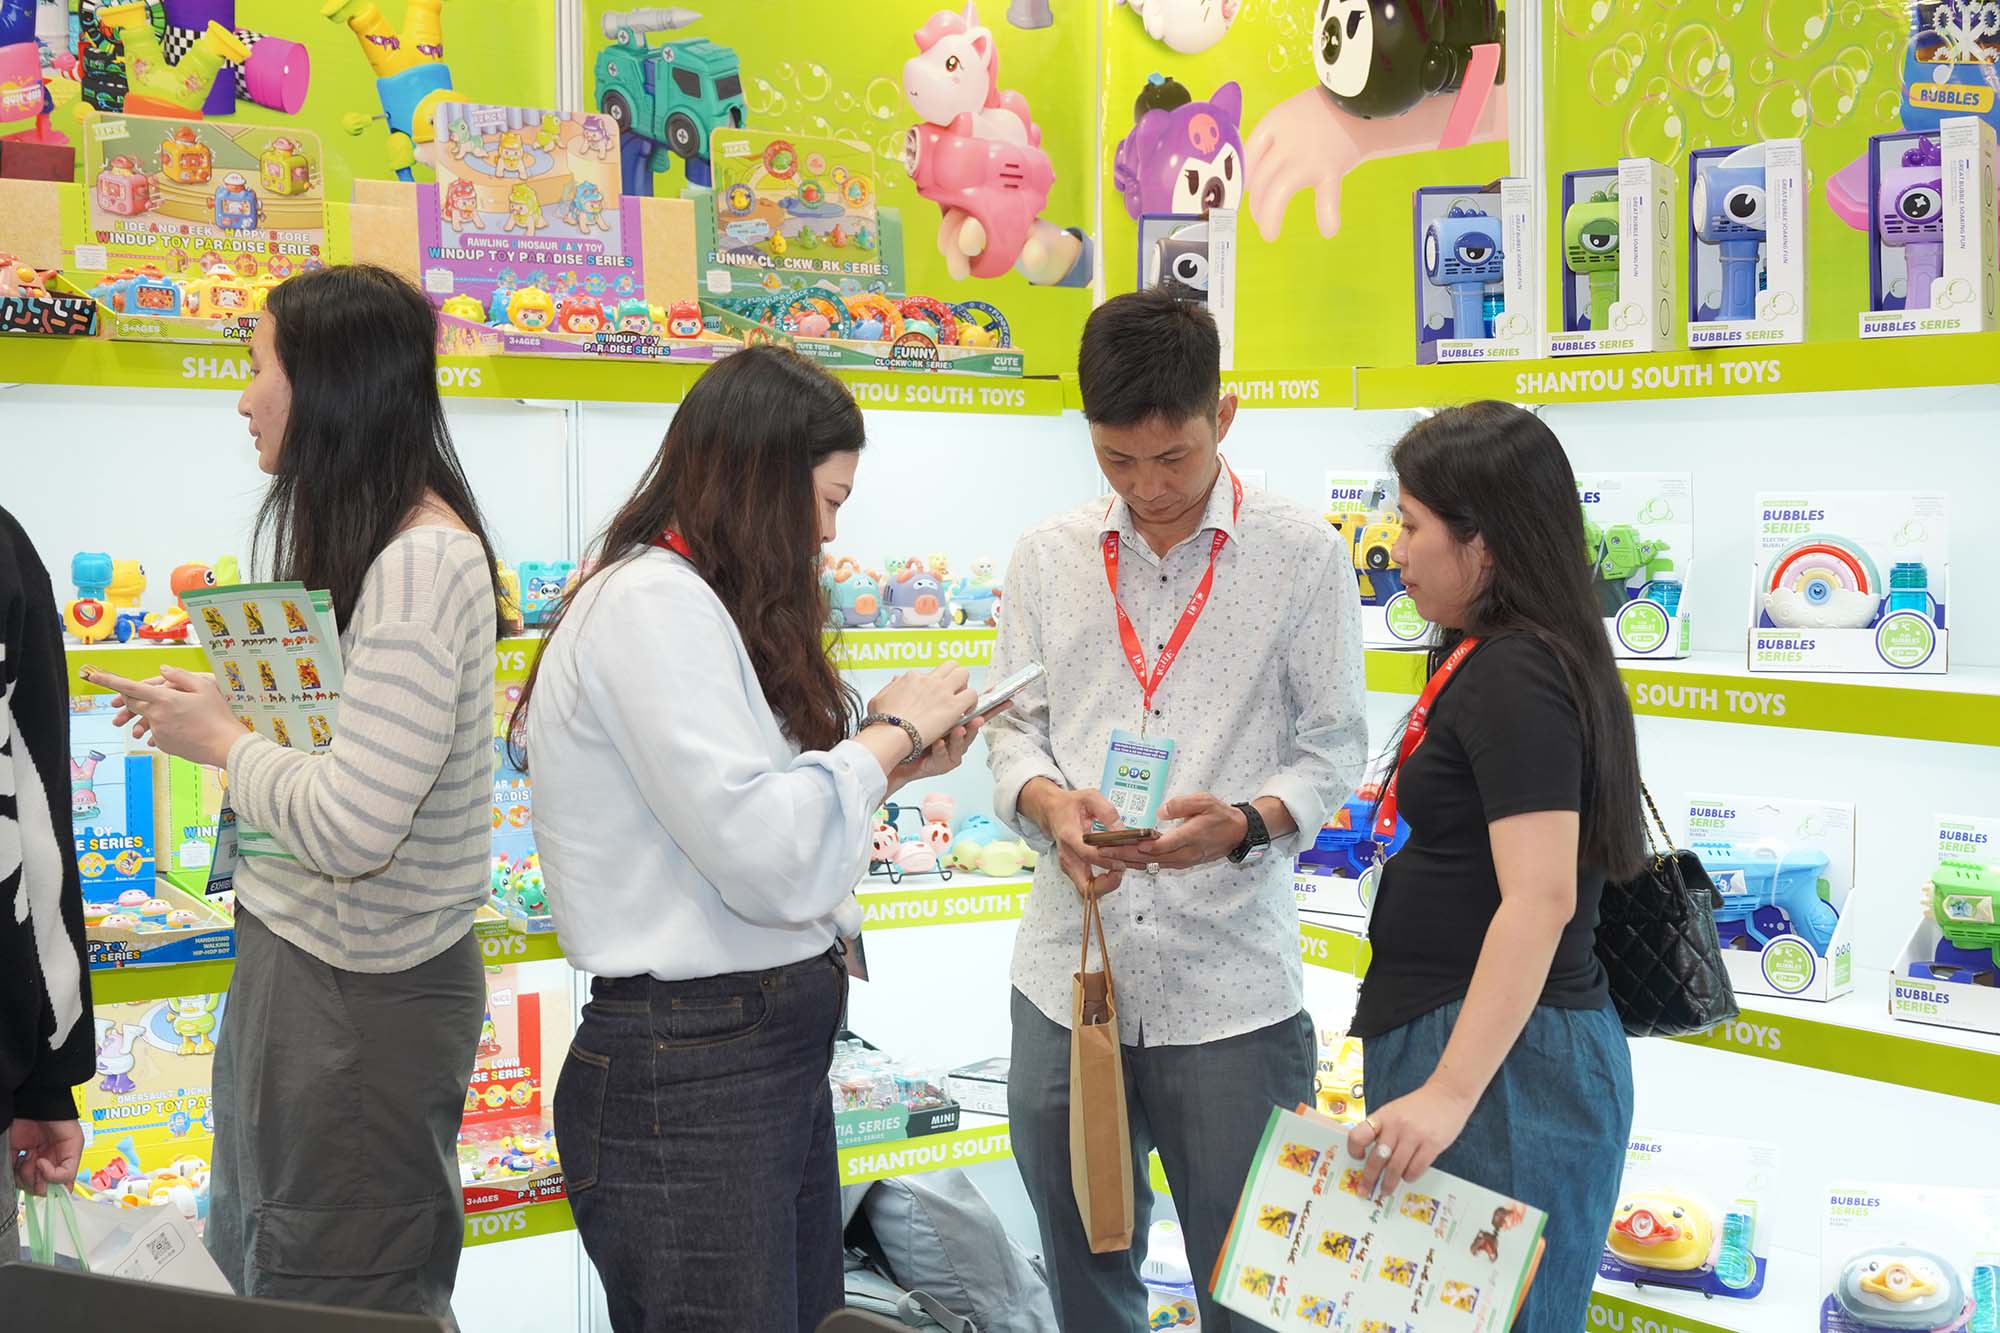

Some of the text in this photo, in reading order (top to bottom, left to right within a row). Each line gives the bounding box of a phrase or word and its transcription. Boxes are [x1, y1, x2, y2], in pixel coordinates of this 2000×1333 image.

[1920, 89, 1980, 106] BUBBLES
[180, 224, 213, 237] SEEK
[224, 228, 266, 240] HAPPY
[270, 231, 310, 242] STORE
[96, 230, 320, 257] WINDUP TOY PARADISE SERIES
[585, 242, 604, 254] TOY
[428, 247, 634, 268] WINDUP TOY PARADISE SERIES
[708, 252, 889, 276] FUNNY CLOCKWORK SERIES
[1864, 319, 1962, 334] BUBBLES SERIES
[508, 336, 541, 347] 3+AGES
[596, 332, 660, 346] WINDUP TOY
[1692, 329, 1784, 343] BUBBLES SERIES
[583, 343, 671, 357] PARADISE SERIES
[1552, 339, 1634, 352] BUBBLES SERIES
[894, 346, 936, 360] FUNNY
[1441, 348, 1520, 358] BUBBLES SERIES
[874, 358, 953, 370] CLOCKWORK SERIES
[994, 356, 1019, 366] CUTE
[436, 367, 482, 388] OYS
[1516, 360, 1781, 395] SHANTOU SOUTH TOYS
[905, 385, 974, 406] SOUTH
[979, 389, 1025, 408] TOYS
[1218, 379, 1320, 401] SOUTH TOYS
[1762, 510, 1825, 521] BUBBLES
[1762, 522, 1812, 534] SERIES
[832, 639, 995, 662] SHANTOU SOUT
[1757, 640, 1816, 650] BUBBLES
[1757, 651, 1803, 663] SERIES
[1636, 682, 1786, 717] SOUTH TOYS
[495, 790, 530, 803] RADIS
[1690, 808, 1736, 819] BUBBLES
[1690, 817, 1726, 828] SERIES
[89, 836, 144, 851] SERIES
[1939, 830, 1988, 844] BUBBLES
[1938, 841, 1977, 854] SERIES
[1294, 882, 1317, 893] BLES
[863, 898, 938, 922] ANTOU
[944, 894, 1011, 917] SOUTH
[103, 941, 128, 952] TOY
[194, 936, 230, 944] HANDSTAND
[203, 942, 230, 950] WALKING
[482, 934, 528, 957] OYS
[1299, 934, 1328, 959] OYS
[100, 950, 140, 962] SERIES
[1896, 987, 1950, 1004] BUBBLES
[1896, 1000, 1938, 1014] SERIES
[1725, 1020, 1782, 1051] TOYS
[490, 1066, 532, 1081] SERIES
[92, 1104, 151, 1121] WINDUP
[156, 1100, 184, 1113] TOY
[858, 1116, 900, 1135] SERIES
[931, 1112, 955, 1125] MINI
[1627, 1142, 1662, 1153] UBBLES
[848, 1134, 1012, 1177] SHANTOU SOUT
[1626, 1152, 1652, 1161] ERIES
[466, 1194, 500, 1206] 3+AGES
[518, 1186, 562, 1200] PRDISE
[1830, 1196, 1880, 1207] BUBBLES
[1830, 1206, 1870, 1216] SERIES
[468, 1210, 527, 1238] TOYS
